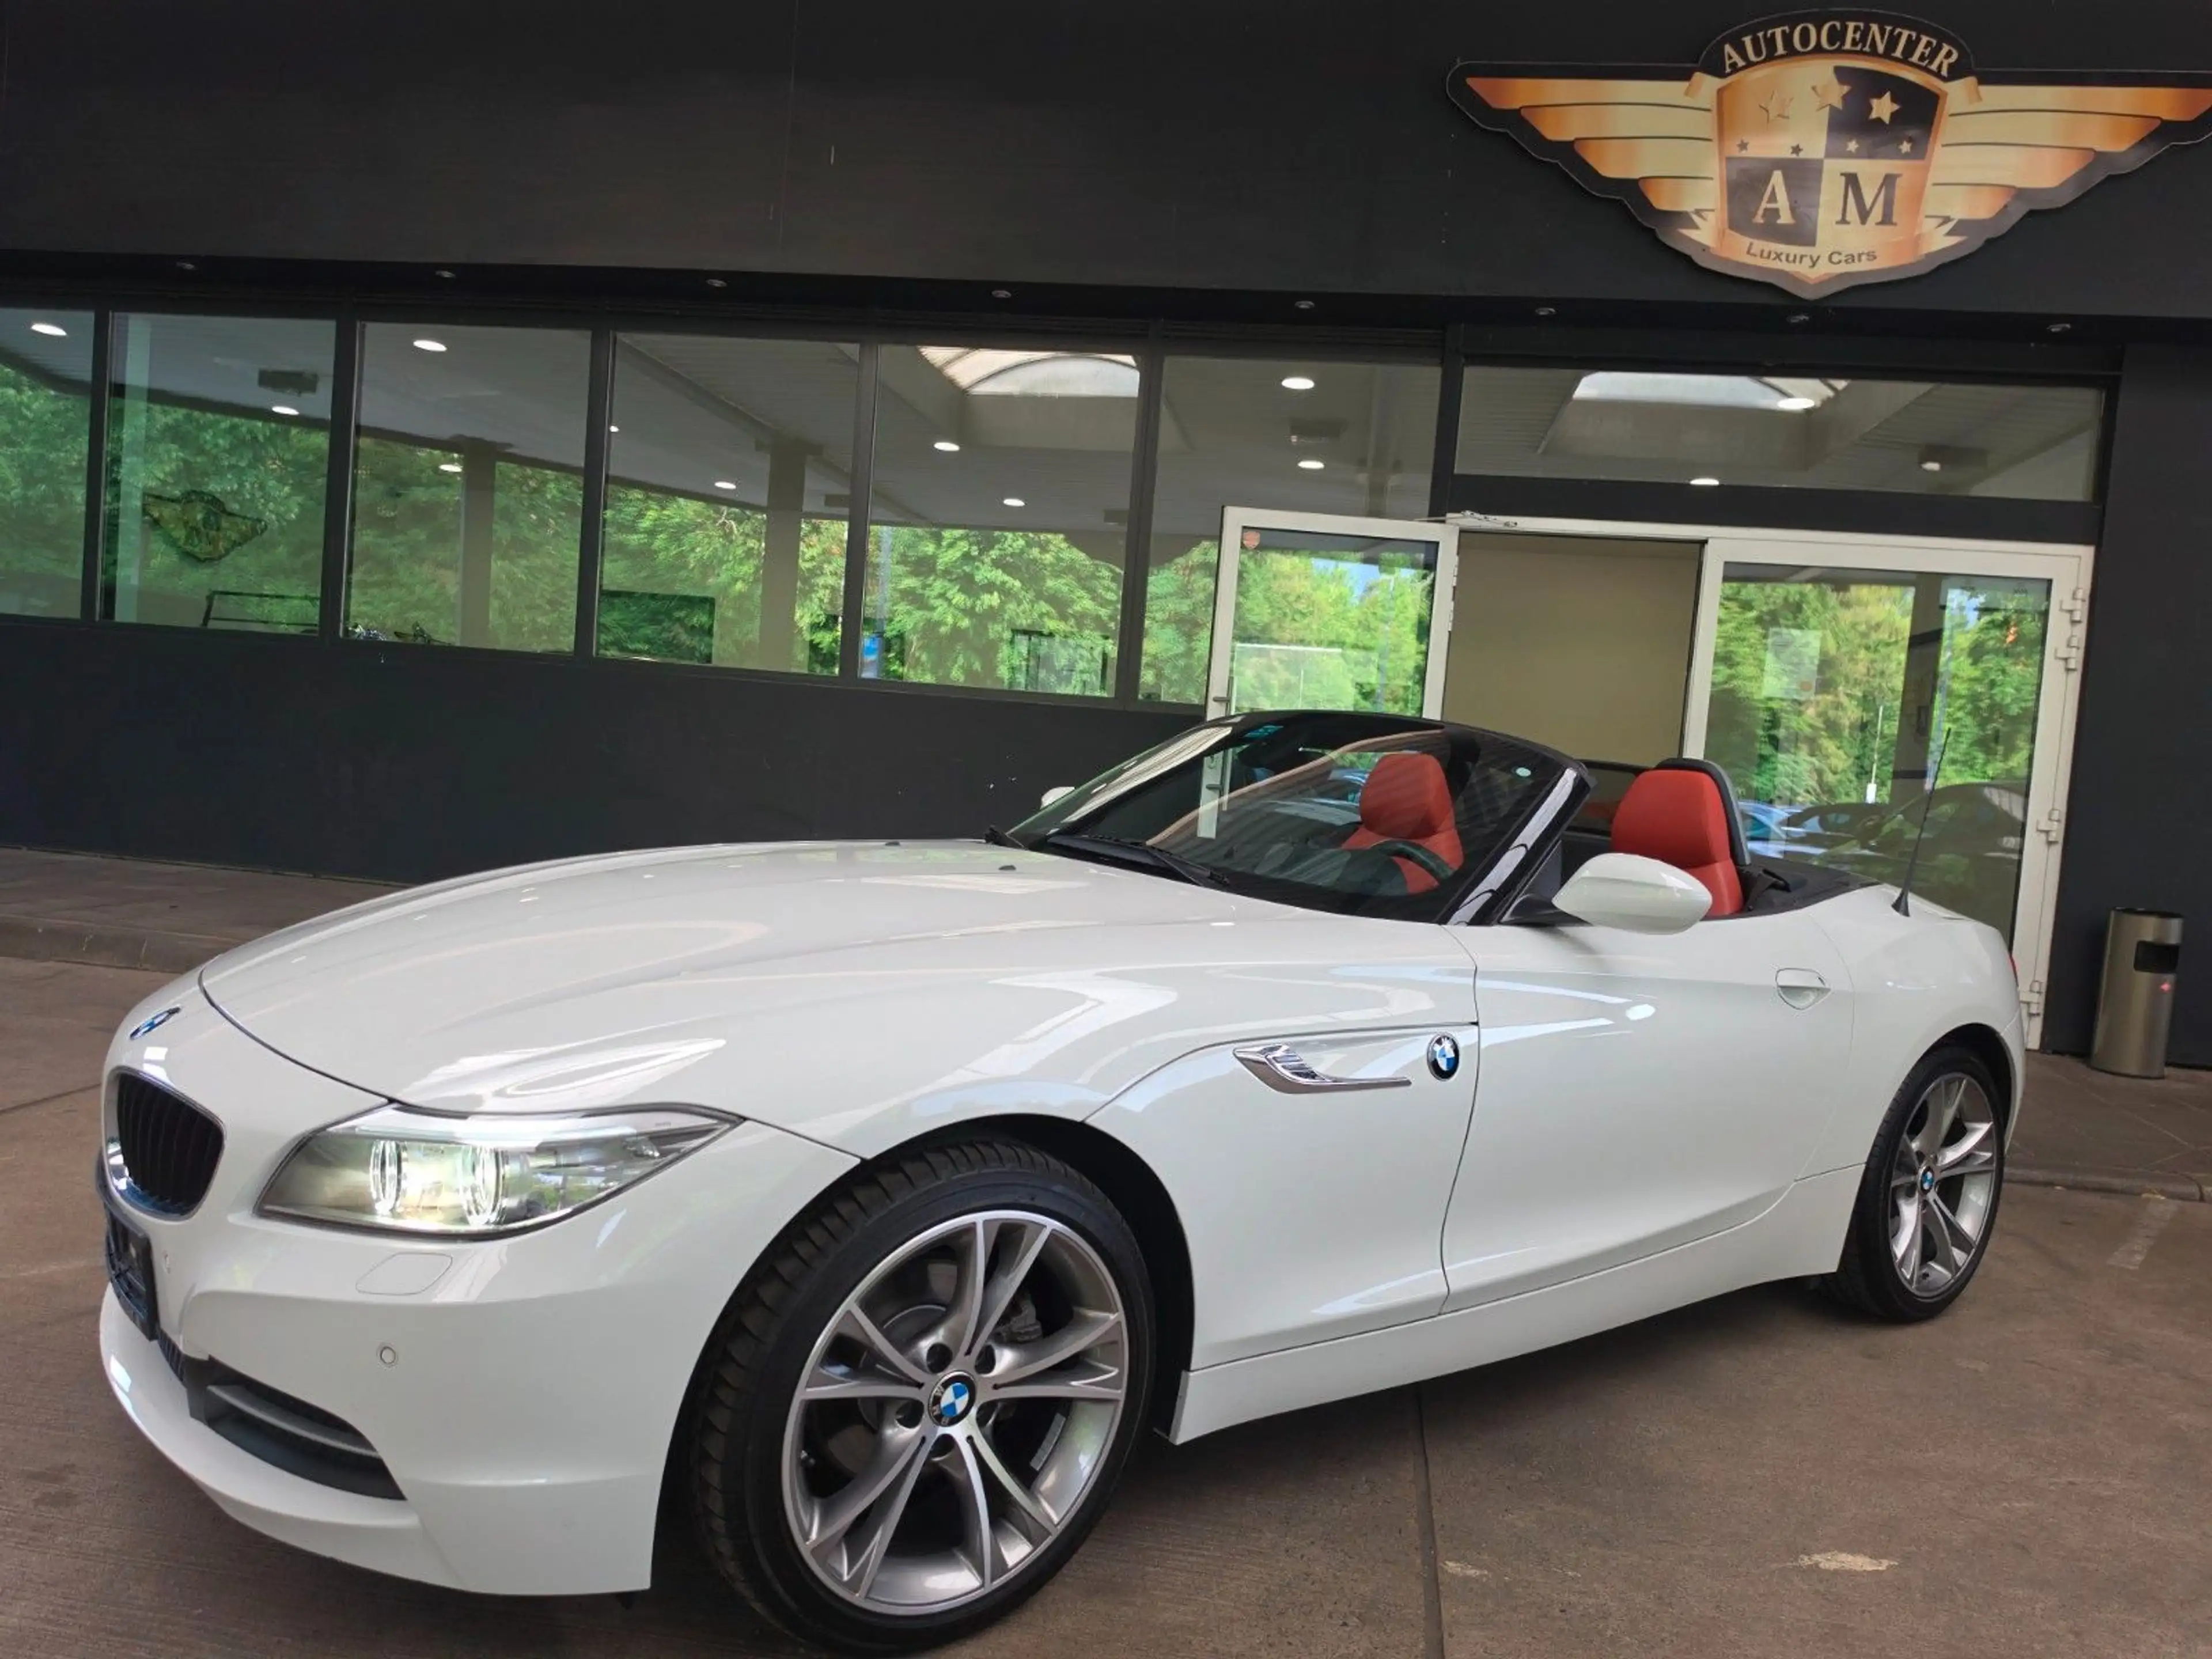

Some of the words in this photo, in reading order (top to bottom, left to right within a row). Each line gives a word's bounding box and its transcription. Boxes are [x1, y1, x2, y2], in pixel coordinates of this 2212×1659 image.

[1722, 21, 1959, 78] AUTOCENTER
[1752, 169, 1796, 224] A
[1835, 172, 1903, 226] M
[1746, 241, 1821, 268] Luxury
[1828, 248, 1878, 266] Cars
